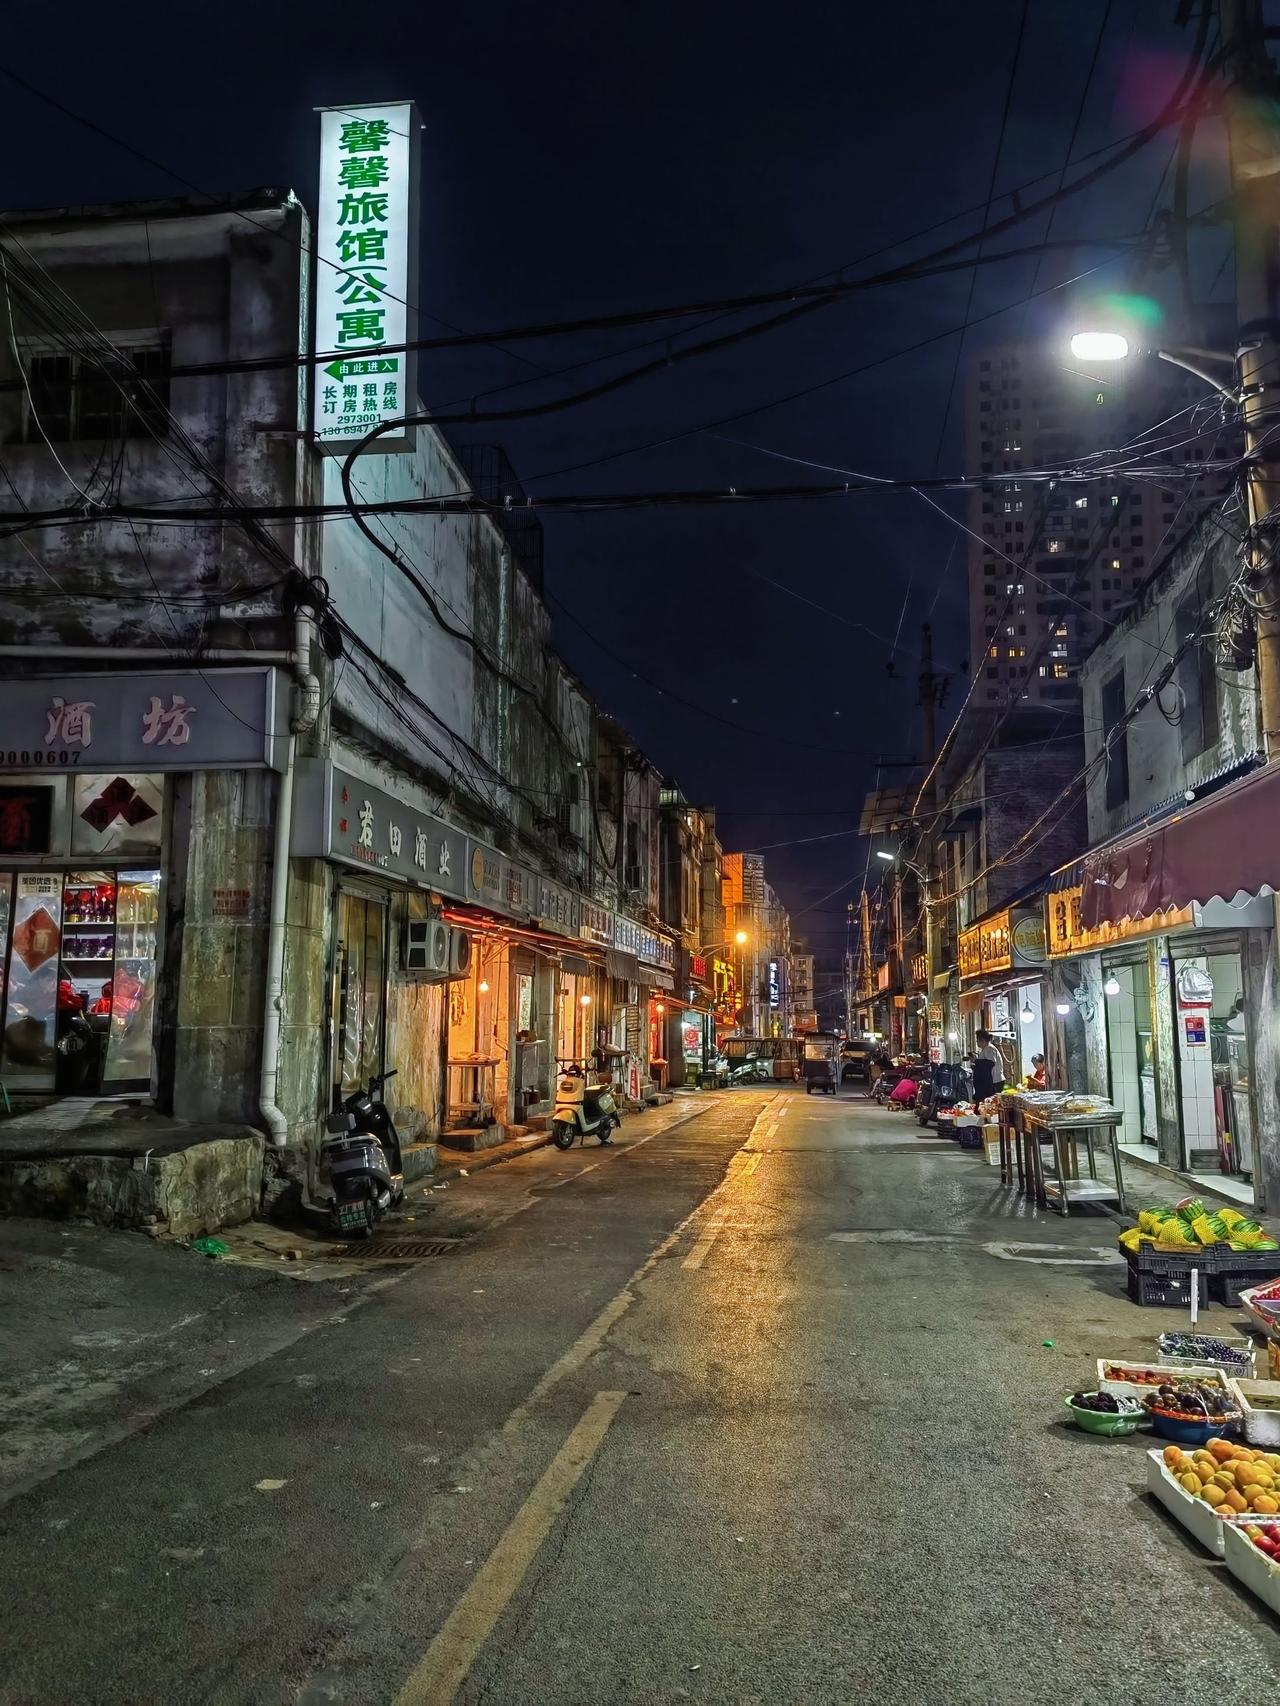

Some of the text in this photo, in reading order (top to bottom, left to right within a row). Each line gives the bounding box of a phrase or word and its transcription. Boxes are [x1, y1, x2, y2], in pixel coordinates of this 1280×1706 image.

[339, 361, 393, 374] 由此进入
[322, 381, 398, 400] 长期租房
[322, 396, 398, 414] 订房热线
[337, 413, 382, 425] 2973001
[44, 695, 197, 748] 酒坊
